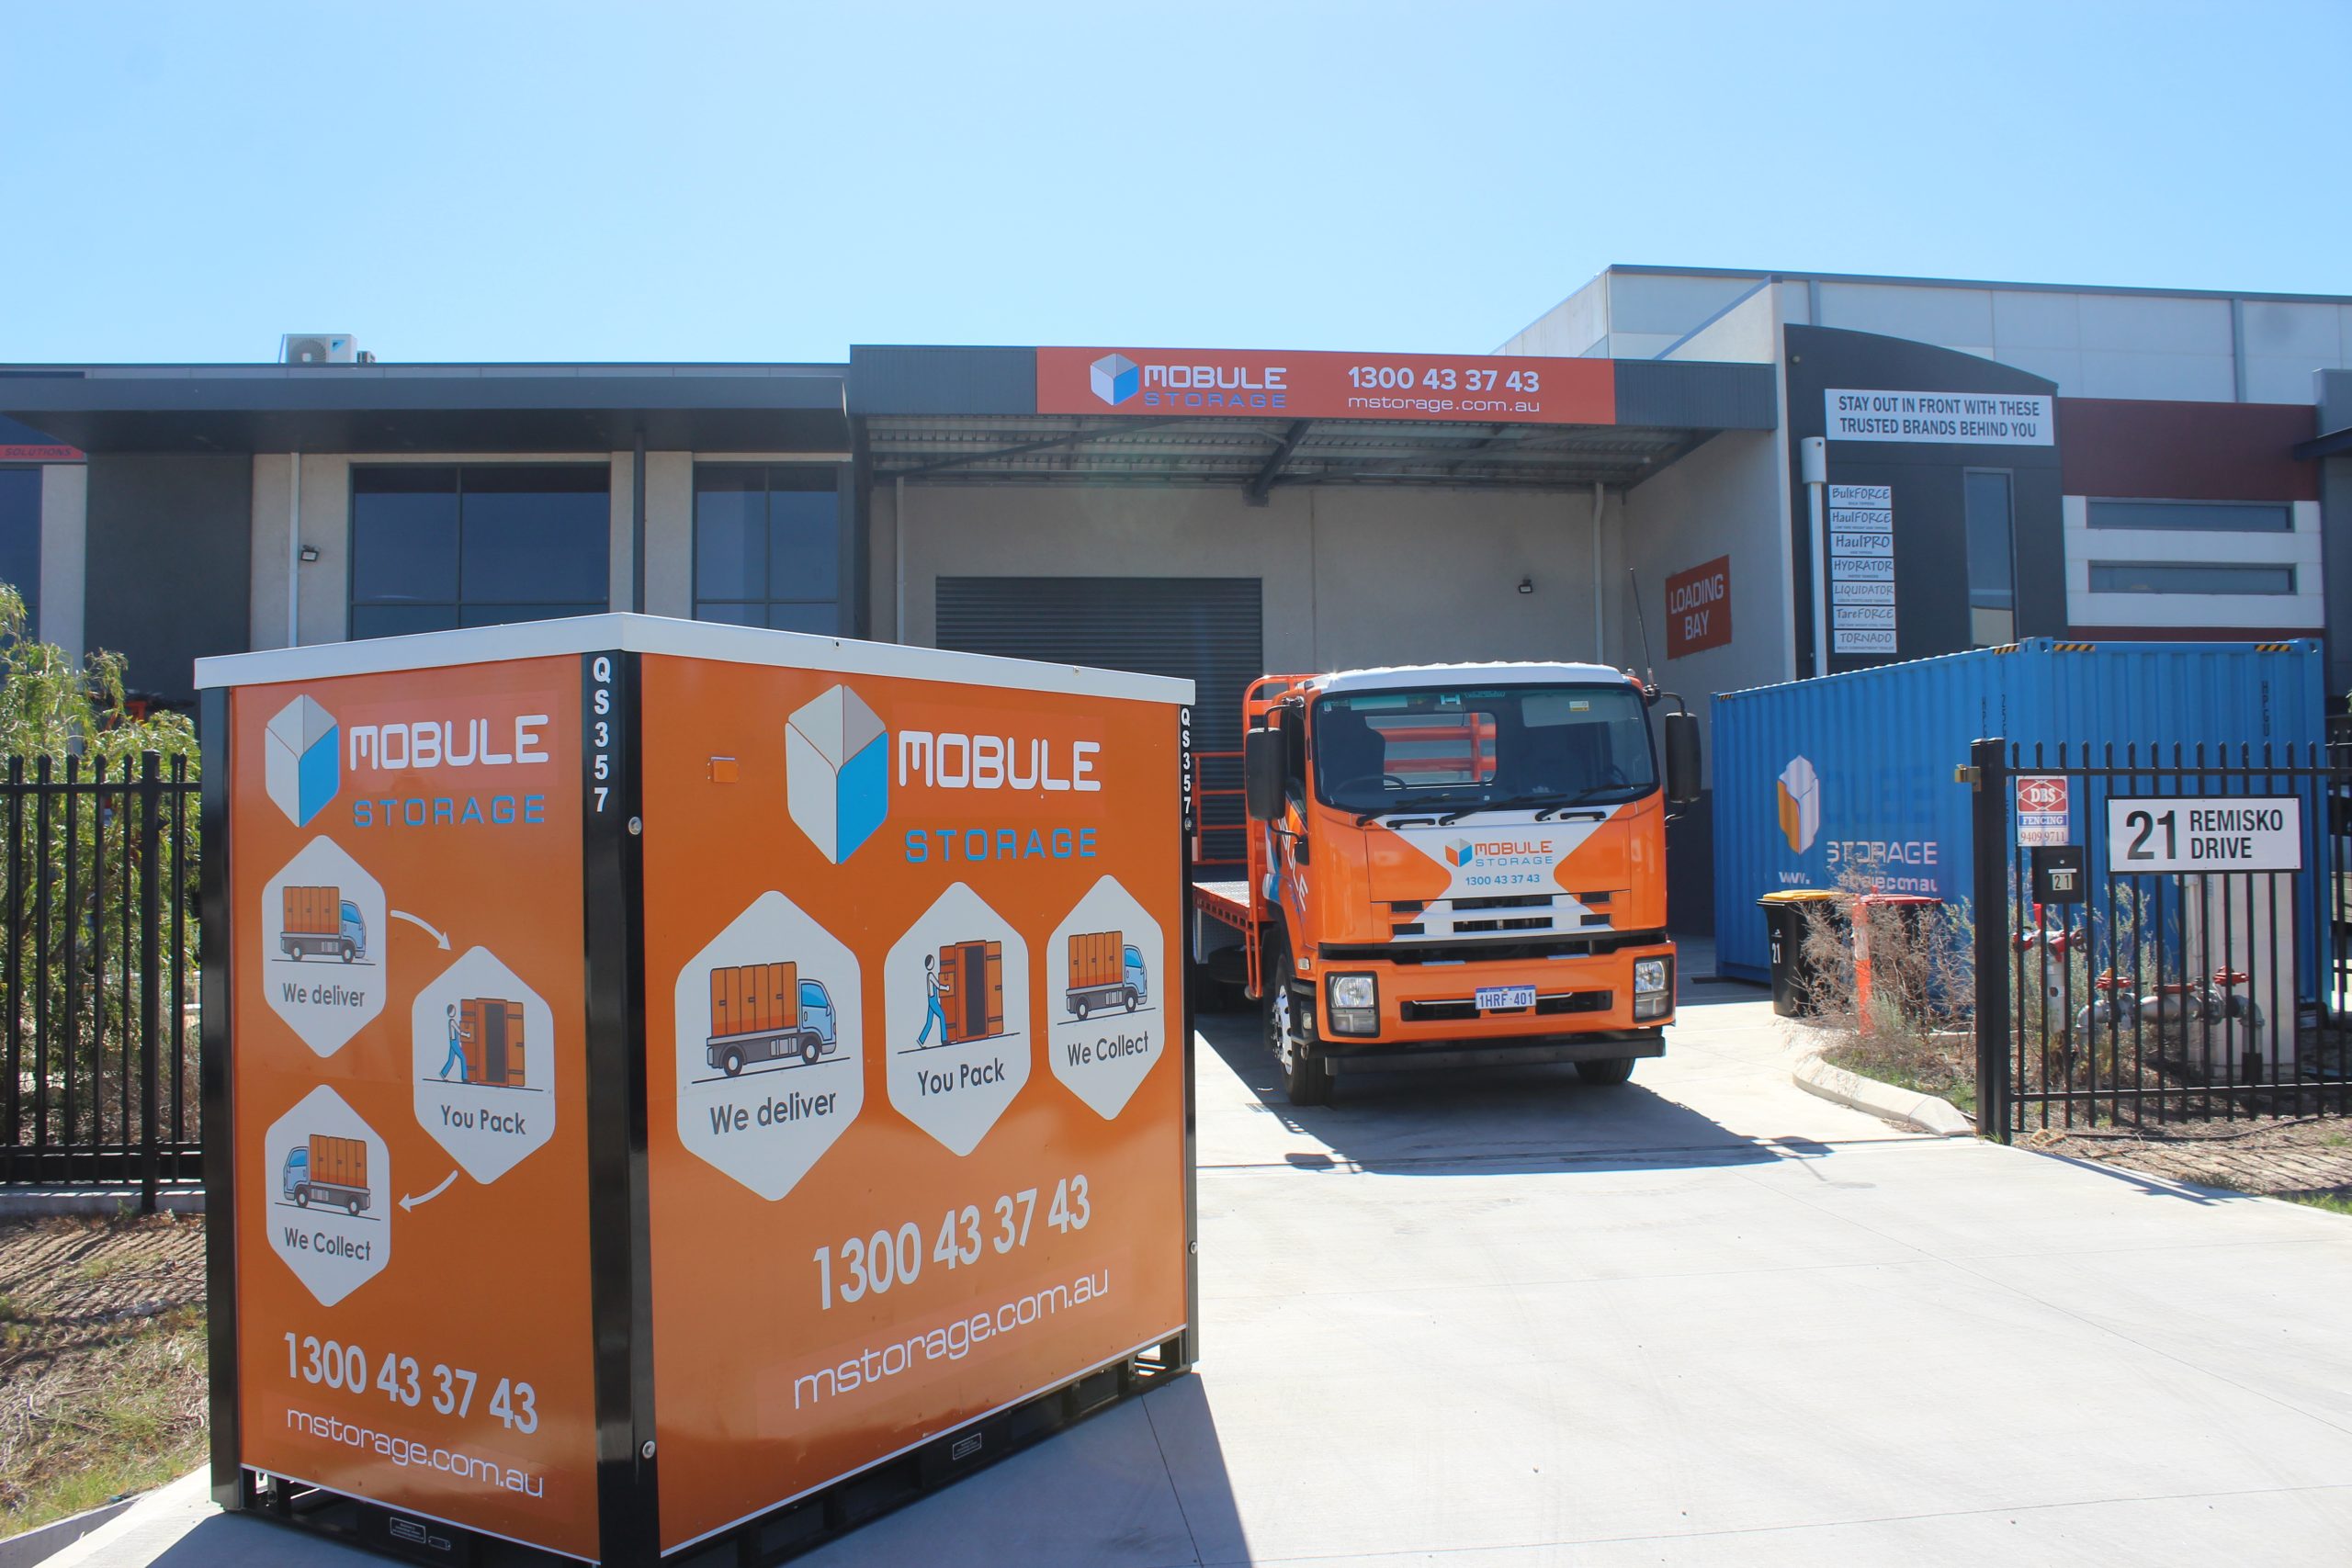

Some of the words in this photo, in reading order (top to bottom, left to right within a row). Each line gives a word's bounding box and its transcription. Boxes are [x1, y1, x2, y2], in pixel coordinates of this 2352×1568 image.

[1145, 365, 1287, 390] MOBULE
[1348, 366, 1415, 391] 1300
[1423, 367, 1456, 391] 43
[1464, 369, 1498, 392] 37
[1506, 370, 1540, 393] 43
[1145, 392, 1286, 409] STORAGE
[1348, 394, 1540, 412] mstorage.com.au
[1838, 396, 1869, 412] STAY
[1873, 397, 1897, 412] OUT
[1902, 398, 1915, 412] IN
[1919, 399, 1961, 414] FRONT
[1964, 400, 1996, 415] WITH
[1999, 400, 2040, 416] THESE
[1839, 417, 1899, 434] TRUSTED
[1904, 419, 1956, 435] BRANDS
[1961, 421, 2007, 436] BEHIND
[2011, 423, 2036, 437] YOU
[1832, 488, 1889, 500] BulkFORCE
[1832, 511, 1891, 524] HaulFORCE
[1836, 535, 1890, 548] HaulPRO
[1834, 559, 1894, 572] HYDRATOR
[1670, 573, 1724, 615] LOADING
[1835, 585, 1894, 596] LIQUIDATOR
[1685, 609, 1710, 640] BAY
[1836, 608, 1894, 619] TareFORCE
[1840, 633, 1892, 643] TORNADO
[349, 714, 548, 772] MOBULE
[899, 730, 1102, 792] MOBULE
[2030, 787, 2056, 803] DBS
[353, 795, 545, 827] STORAGE
[2022, 816, 2064, 825] FENCING
[2189, 809, 2283, 833] REMISKO
[905, 828, 1097, 863] STORAGE
[2020, 831, 2042, 842] 9409
[2044, 831, 2064, 842] 9711
[2126, 810, 2177, 860] 21
[1475, 840, 1553, 856] MOBULE
[2190, 836, 2253, 860] DRIVE
[1476, 856, 1553, 867] STORAGE
[1465, 876, 1490, 886] 1300
[1494, 875, 1508, 885] 43
[1511, 874, 1523, 884] 37
[1527, 874, 1540, 883] 43
[2054, 874, 2070, 889] 21
[1772, 942, 1781, 964] 21
[282, 983, 307, 1005] We
[311, 985, 365, 1008] deliver
[1068, 1043, 1092, 1066] We
[1096, 1031, 1149, 1061] Collect
[917, 1069, 954, 1097] You
[960, 1058, 1005, 1088] Pack
[441, 1105, 473, 1130] You
[481, 1109, 526, 1135] Pack
[709, 1104, 749, 1135] We
[757, 1090, 836, 1127] deliver
[284, 1227, 309, 1250] We
[314, 1233, 371, 1261] Collect
[813, 1223, 922, 1310] 1300
[933, 1204, 982, 1269] 43
[993, 1188, 1037, 1254] 37
[1047, 1174, 1091, 1234] 43
[795, 1269, 1108, 1410] mstorage.com.au
[284, 1332, 367, 1394] 1300
[377, 1352, 421, 1407] 43
[432, 1364, 478, 1419] 37
[490, 1378, 538, 1435] 43
[288, 1406, 544, 1499] mstorage.com.au
